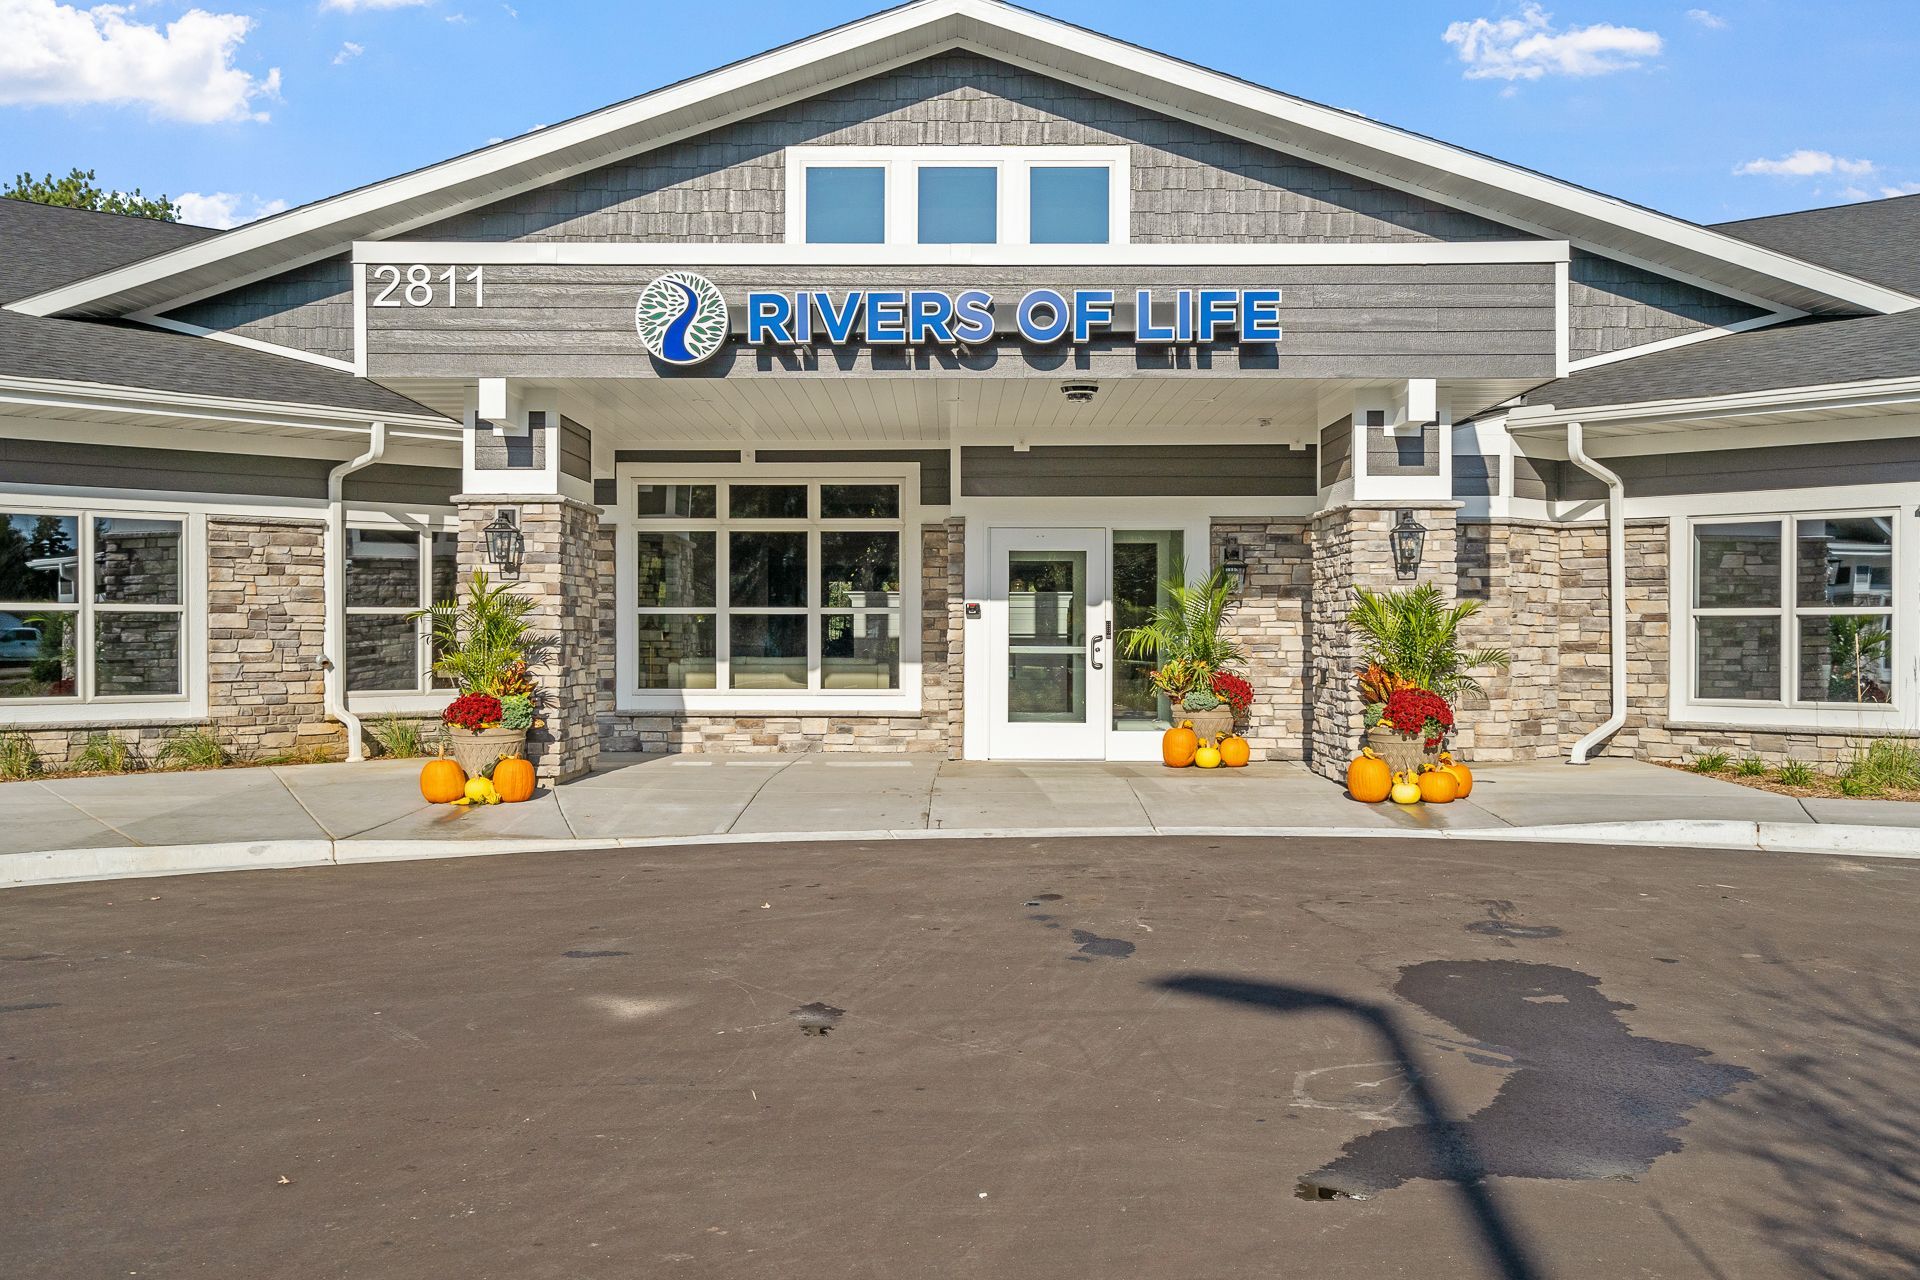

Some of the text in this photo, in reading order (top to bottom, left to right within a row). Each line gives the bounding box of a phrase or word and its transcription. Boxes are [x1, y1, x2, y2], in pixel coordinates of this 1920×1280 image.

[373, 264, 484, 307] 2811
[747, 288, 1283, 344] RIVERS OF LIFE
